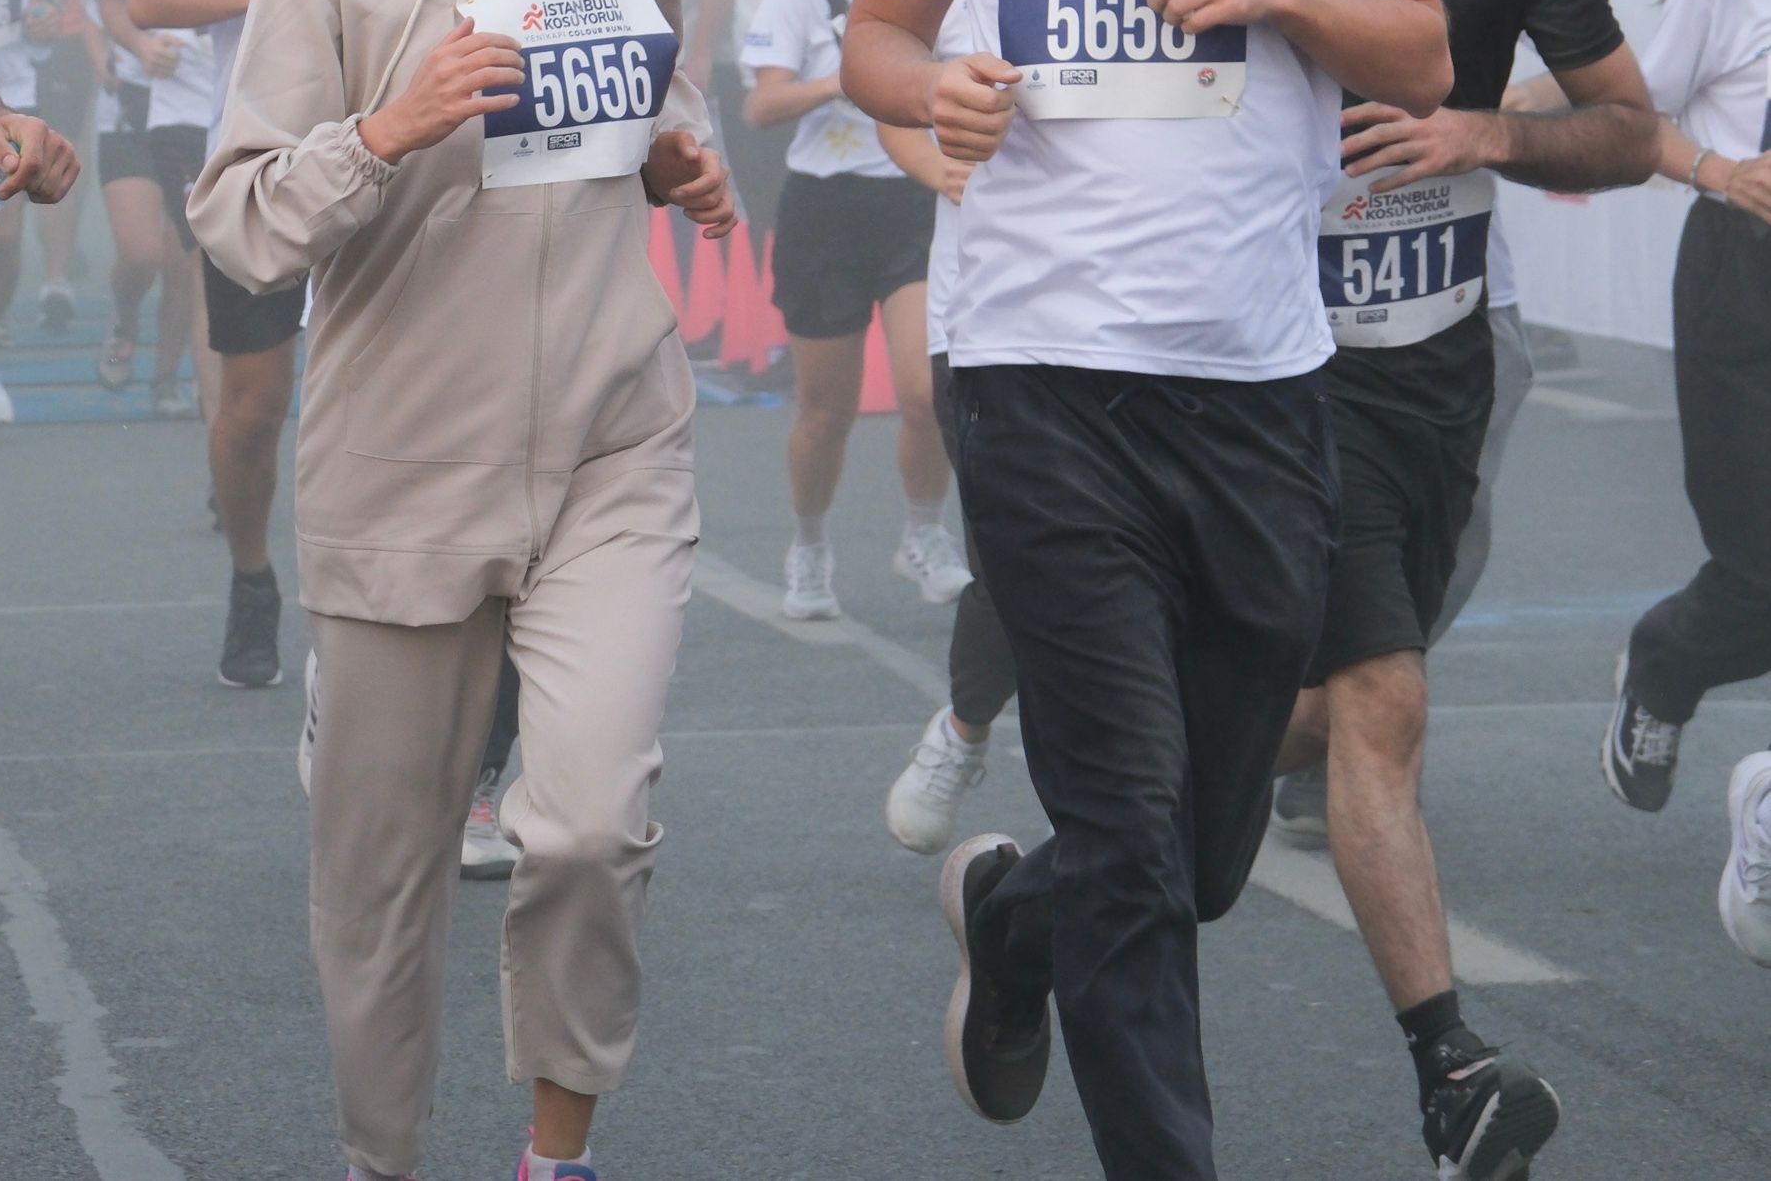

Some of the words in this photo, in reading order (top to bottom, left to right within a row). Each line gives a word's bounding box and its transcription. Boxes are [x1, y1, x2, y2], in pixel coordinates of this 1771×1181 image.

[569, 28, 603, 37] COLOUR
[530, 40, 652, 127] 5656
[1342, 225, 1455, 305] 5411
